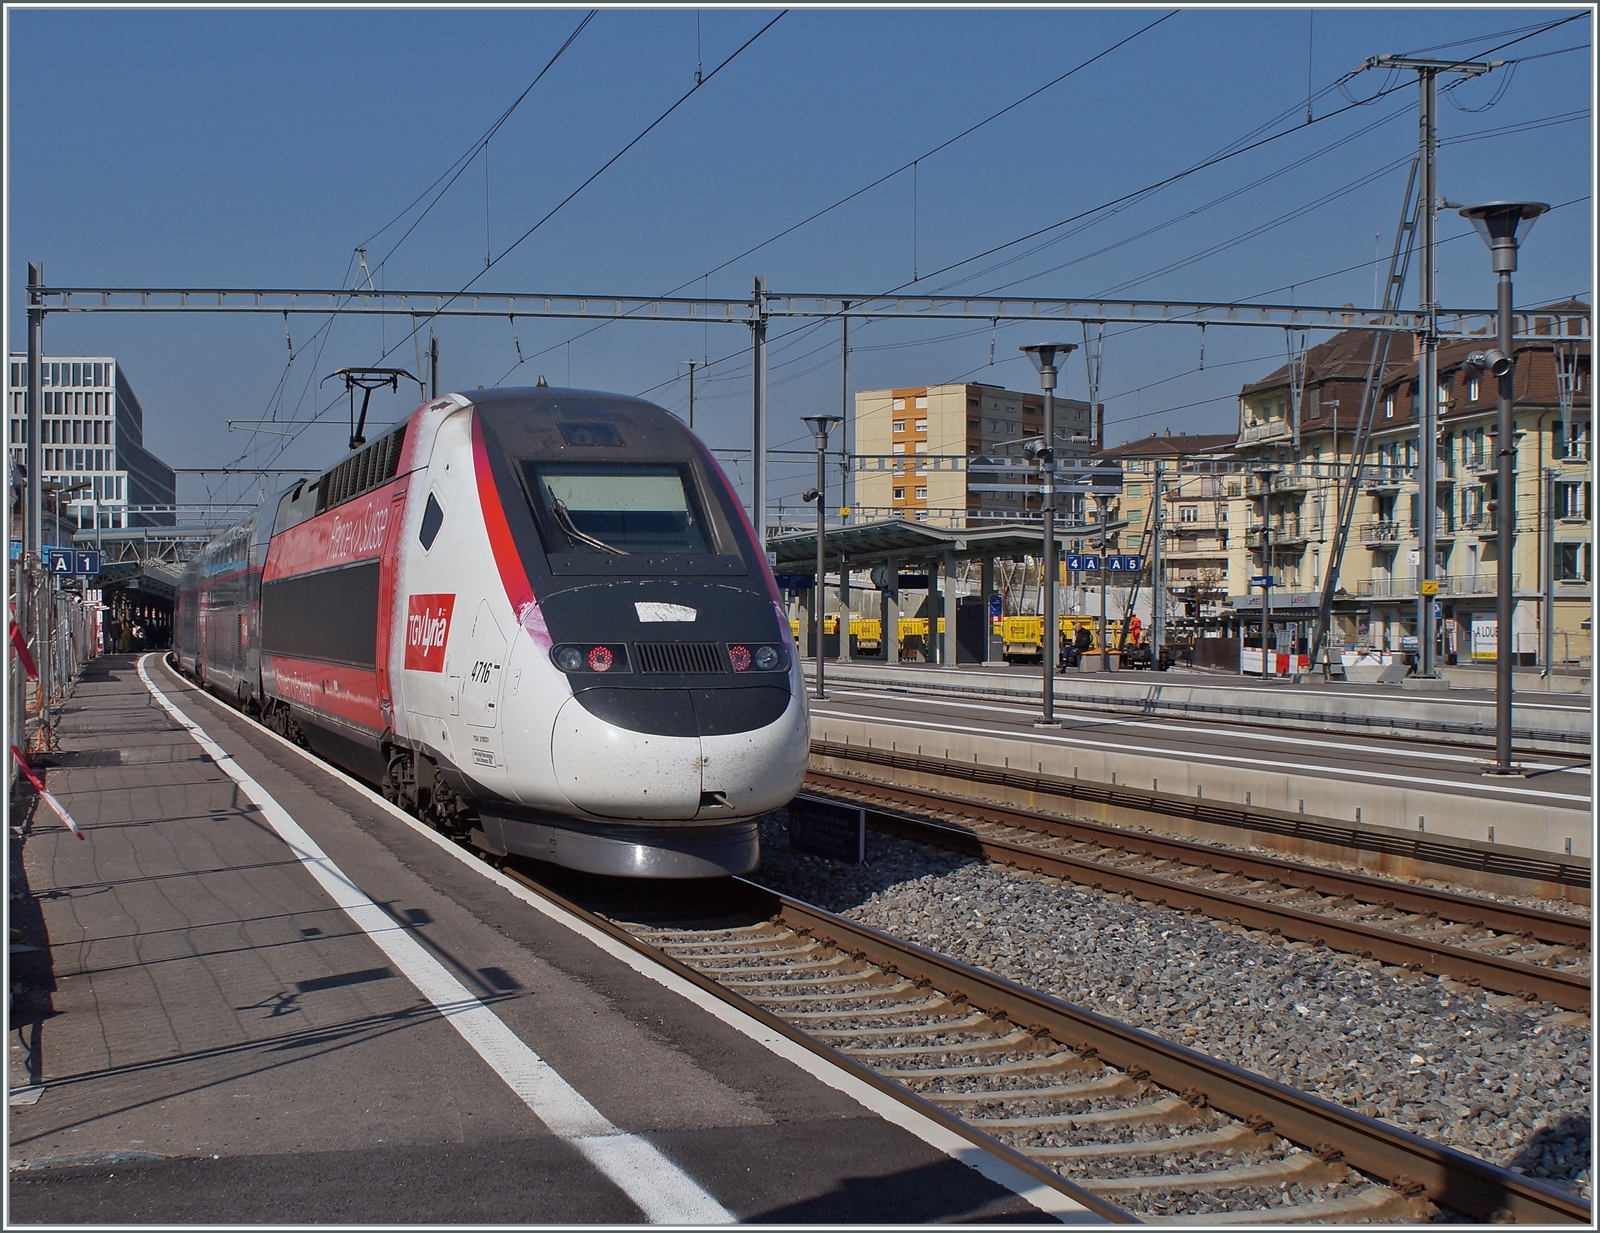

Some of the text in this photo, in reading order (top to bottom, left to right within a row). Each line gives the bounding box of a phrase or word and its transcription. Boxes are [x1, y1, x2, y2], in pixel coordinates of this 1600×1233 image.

[56, 557, 67, 571] A
[83, 557, 90, 571] 1
[1071, 559, 1078, 568] 4
[1087, 560, 1095, 569] A
[1112, 560, 1121, 569] A
[1129, 560, 1136, 569] 5
[408, 607, 447, 657] TGV Lyria
[1475, 626, 1498, 638] A LOUE
[470, 661, 492, 684] 4716
